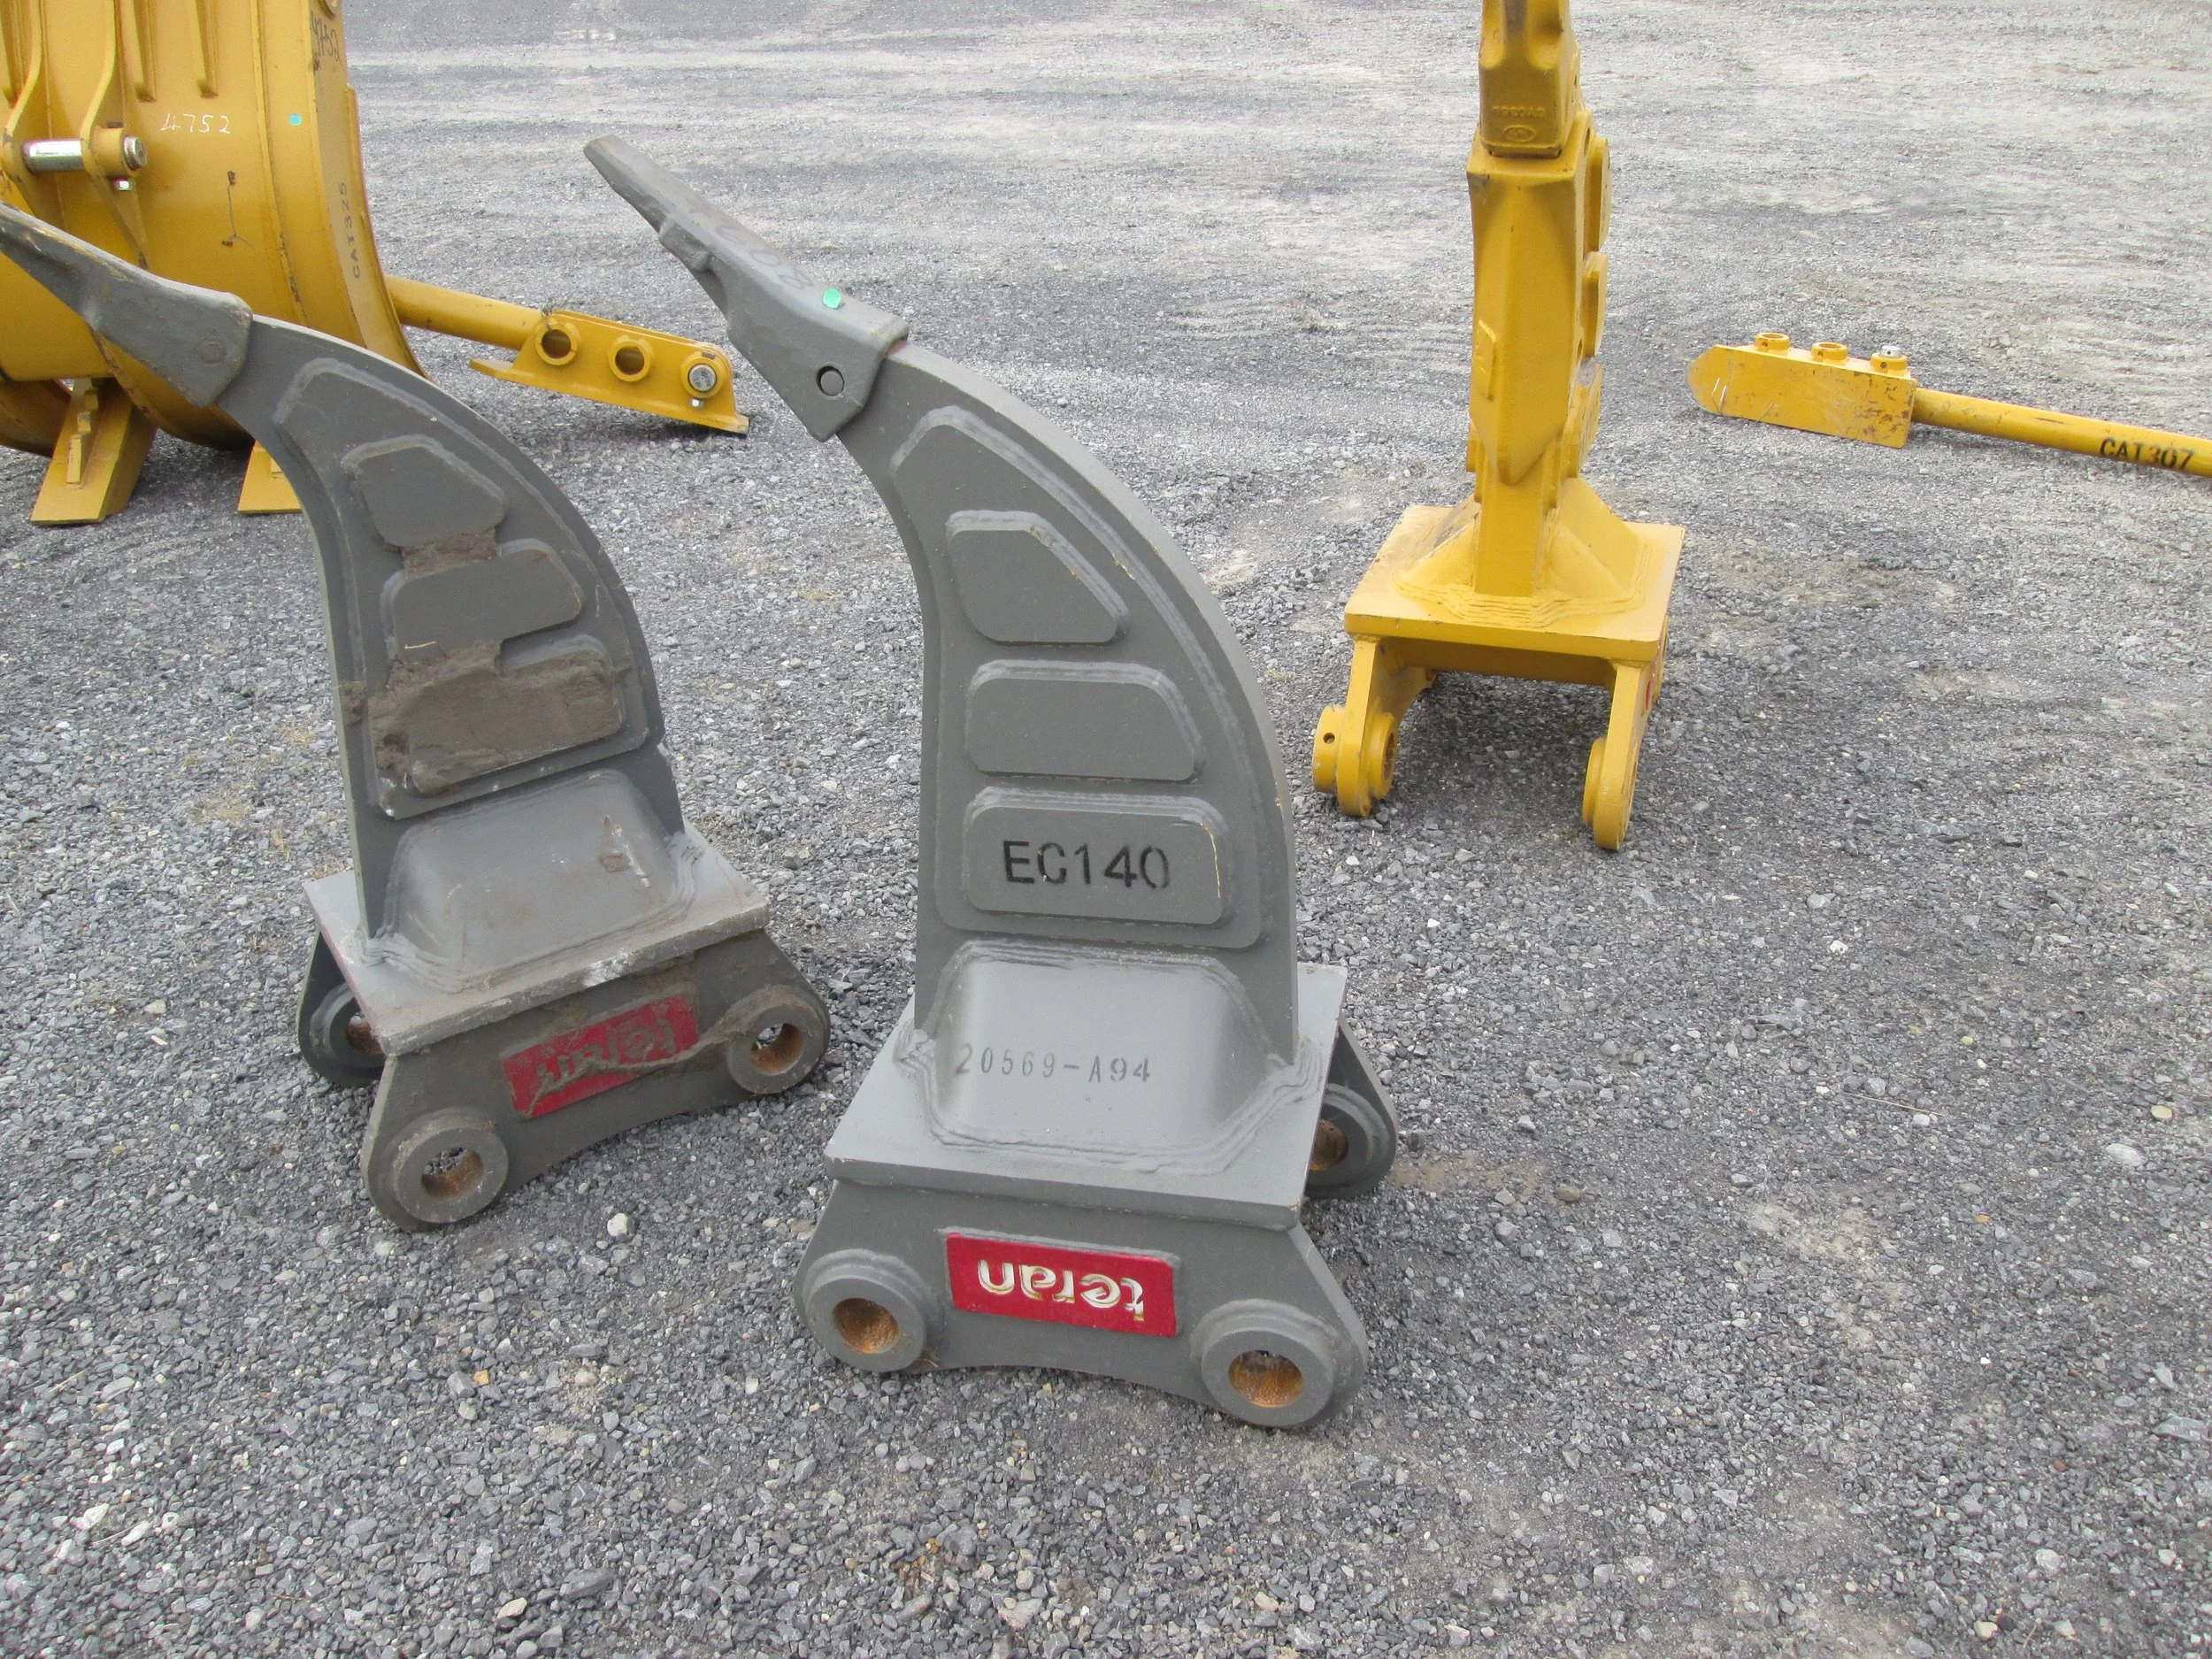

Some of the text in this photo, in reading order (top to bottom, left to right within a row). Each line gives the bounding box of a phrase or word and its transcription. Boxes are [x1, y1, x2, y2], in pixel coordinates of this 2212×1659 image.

[160, 113, 230, 134] 4752
[339, 182, 360, 280] CAT325
[2100, 437, 2195, 470] CAT307
[1002, 840, 1171, 890] EC140
[956, 1042, 1150, 1083] 20569-A94
[978, 1260, 1145, 1322] teran
